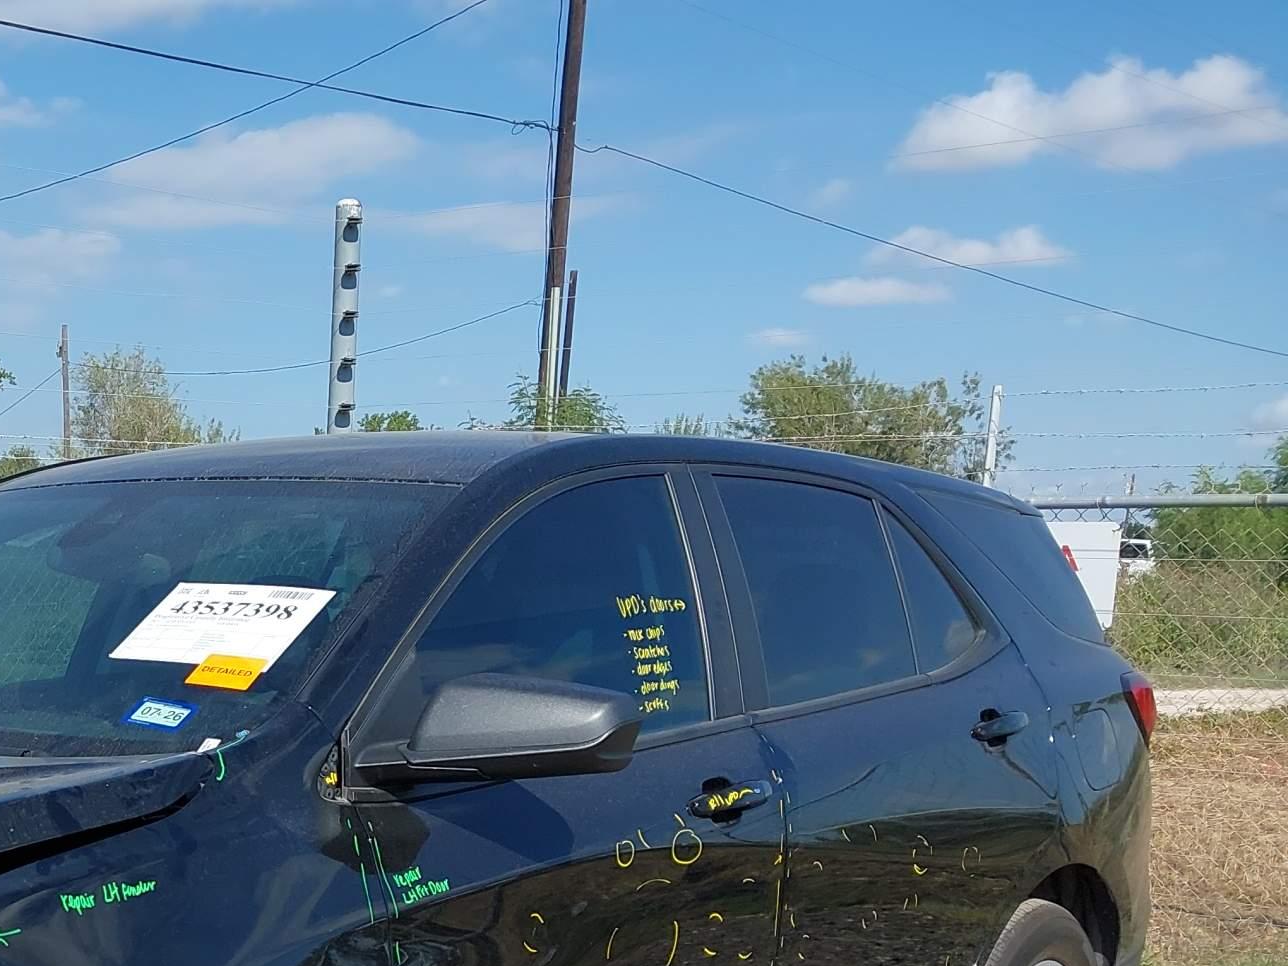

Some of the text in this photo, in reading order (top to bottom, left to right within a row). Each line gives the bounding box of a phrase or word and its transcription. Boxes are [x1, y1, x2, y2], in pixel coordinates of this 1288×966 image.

[170, 600, 298, 620] 43537398
[201, 665, 253, 678] DETAILED
[141, 706, 185, 721] 07 26
[102, 881, 121, 903] LH
